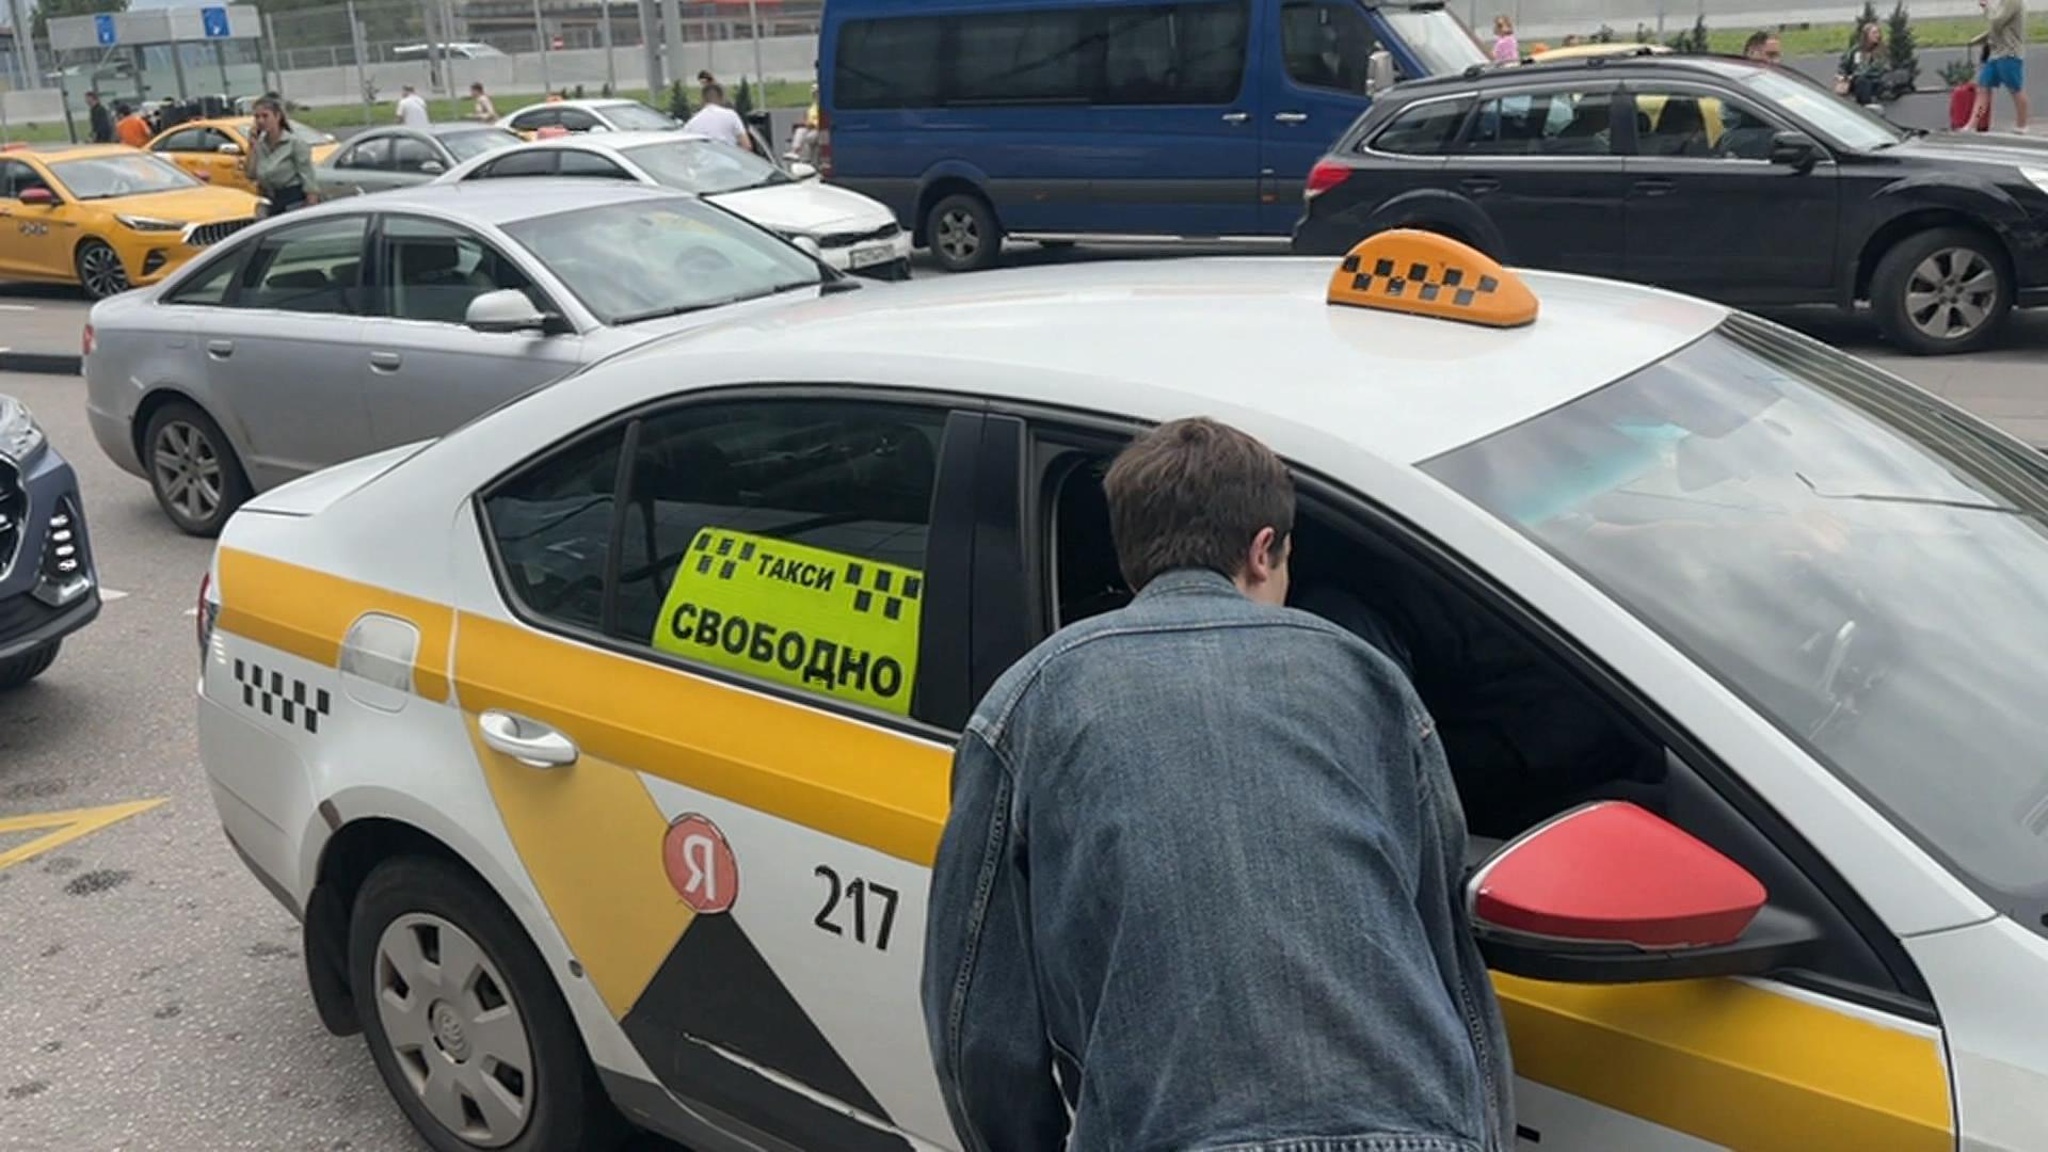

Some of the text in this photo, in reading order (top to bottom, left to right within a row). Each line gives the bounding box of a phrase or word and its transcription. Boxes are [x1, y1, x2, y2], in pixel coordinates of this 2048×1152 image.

[758, 553, 835, 591] ТАКСИ
[671, 602, 901, 697] СВОБОДНО
[683, 833, 716, 901] Я
[814, 864, 899, 951] 217
